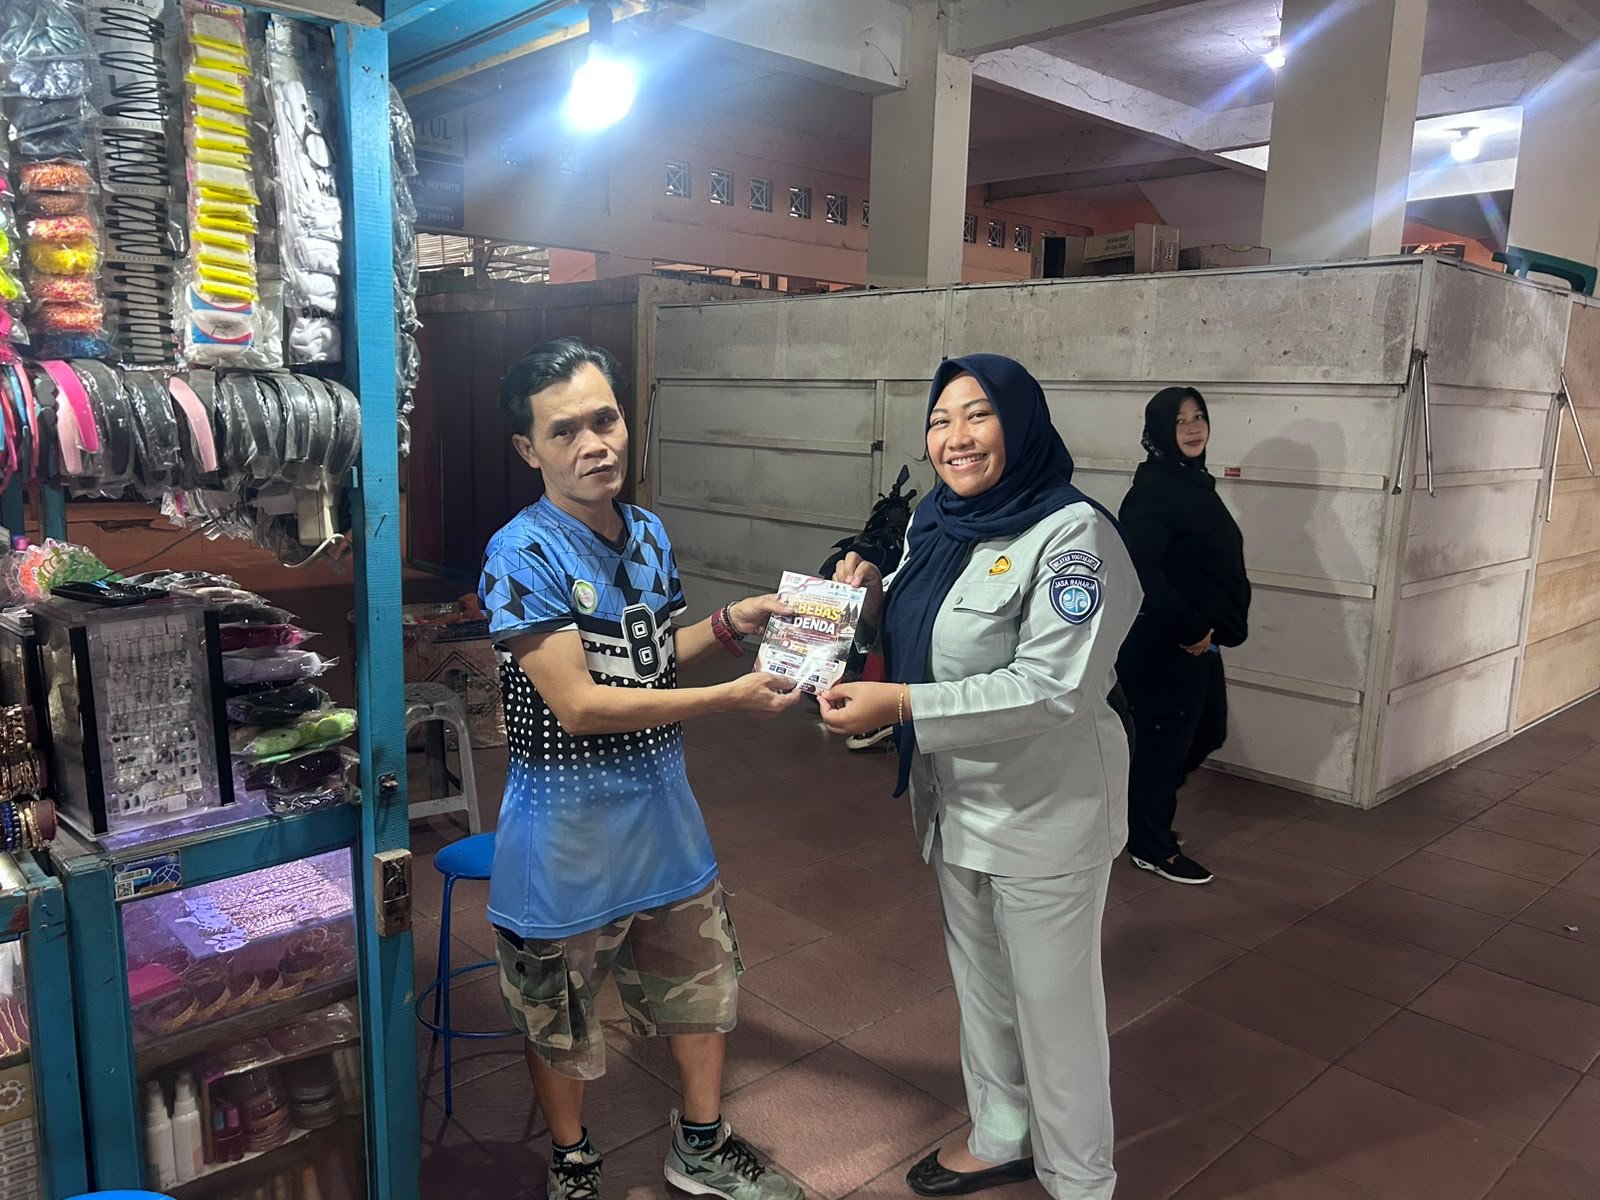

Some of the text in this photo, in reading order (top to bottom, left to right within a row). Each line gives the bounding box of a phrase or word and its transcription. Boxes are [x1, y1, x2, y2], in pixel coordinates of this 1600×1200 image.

[1054, 580, 1096, 590] JASA RAHARJA
[793, 617, 835, 635] DENDA
